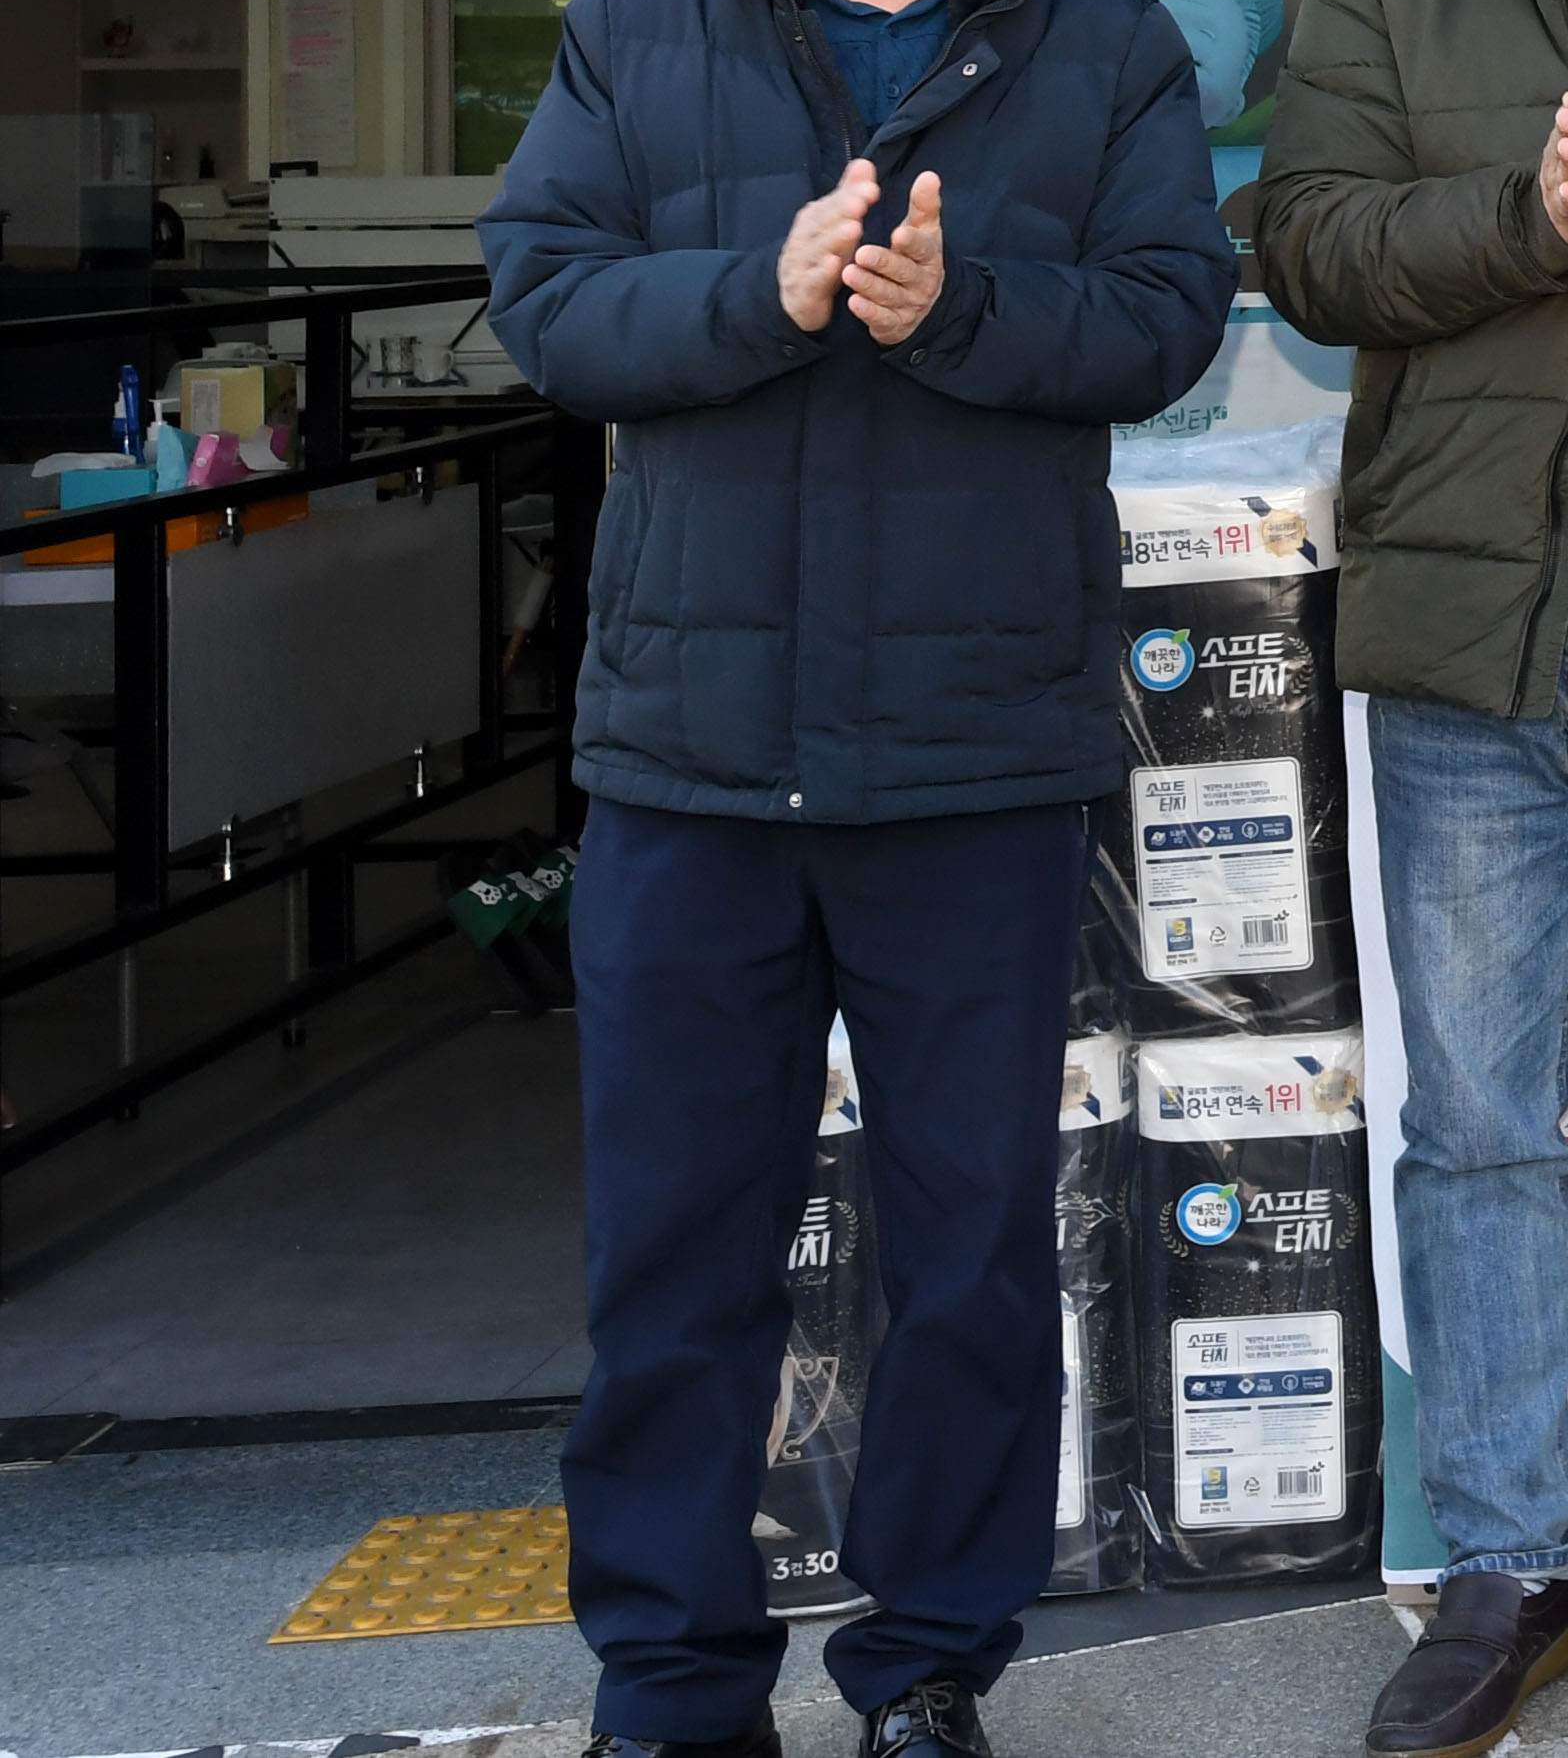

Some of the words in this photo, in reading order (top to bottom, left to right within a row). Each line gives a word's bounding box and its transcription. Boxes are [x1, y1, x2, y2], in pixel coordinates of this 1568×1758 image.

[1135, 541, 1169, 565] 8년
[1174, 538, 1212, 560] 연속
[1213, 523, 1252, 555] 1위
[1144, 649, 1182, 662] 깨끗한
[1199, 632, 1288, 669] 소프트
[1151, 663, 1176, 675] 나라
[1229, 662, 1289, 699] 터치
[1186, 1097, 1220, 1119] 8년
[1225, 1095, 1264, 1116] 연속
[1264, 1083, 1302, 1113] 1위
[1189, 1202, 1228, 1216] 깨끗한
[1245, 1188, 1332, 1224] 소프트
[1196, 1218, 1221, 1228] 나라
[1274, 1219, 1334, 1254] 터치
[1186, 1332, 1228, 1349] 소프트
[1200, 1347, 1229, 1363] 터치
